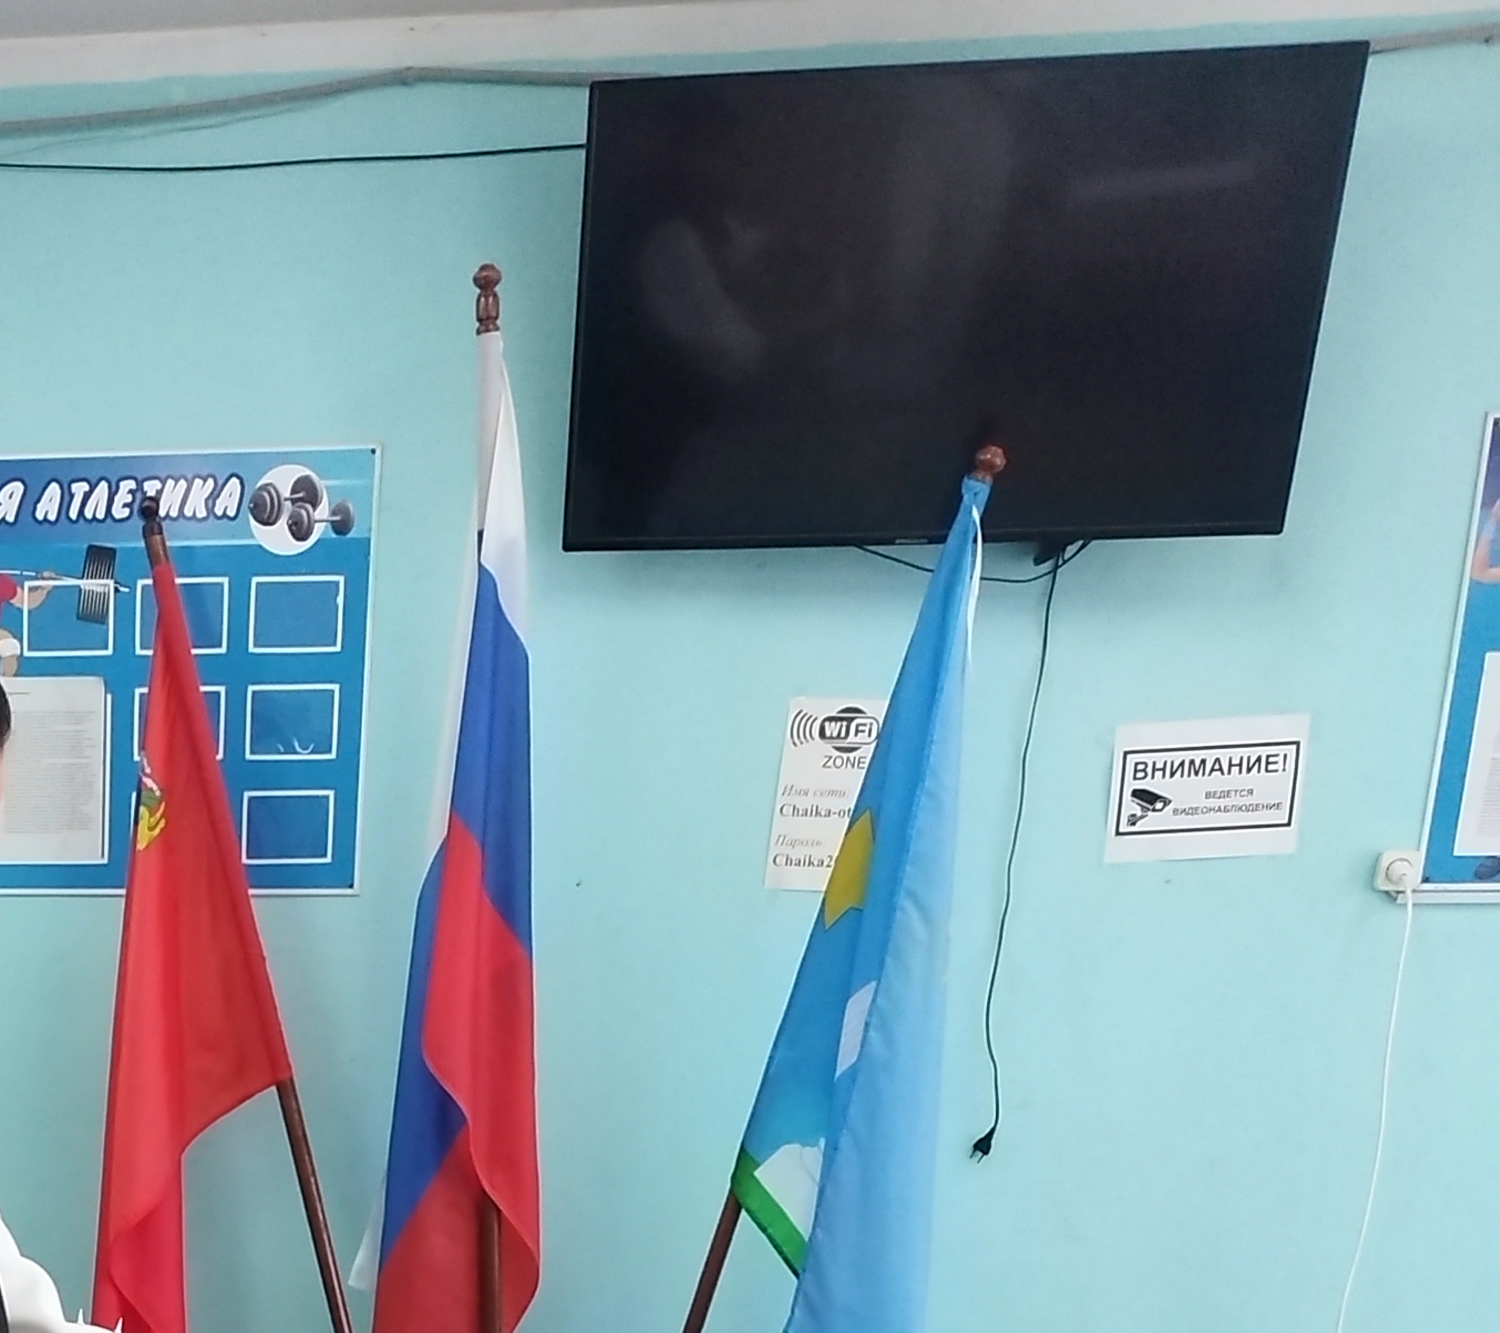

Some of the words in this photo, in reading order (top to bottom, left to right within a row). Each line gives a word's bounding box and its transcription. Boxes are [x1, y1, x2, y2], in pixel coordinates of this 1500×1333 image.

[821, 755, 868, 770] ZONE
[1132, 752, 1288, 781] ВНИМАНИЕ!
[781, 784, 810, 797] Имя
[1204, 788, 1254, 800] ВЕДЕТСЯ
[1172, 801, 1283, 817] ВИДЕОНАБЛЮДЕНИЕ
